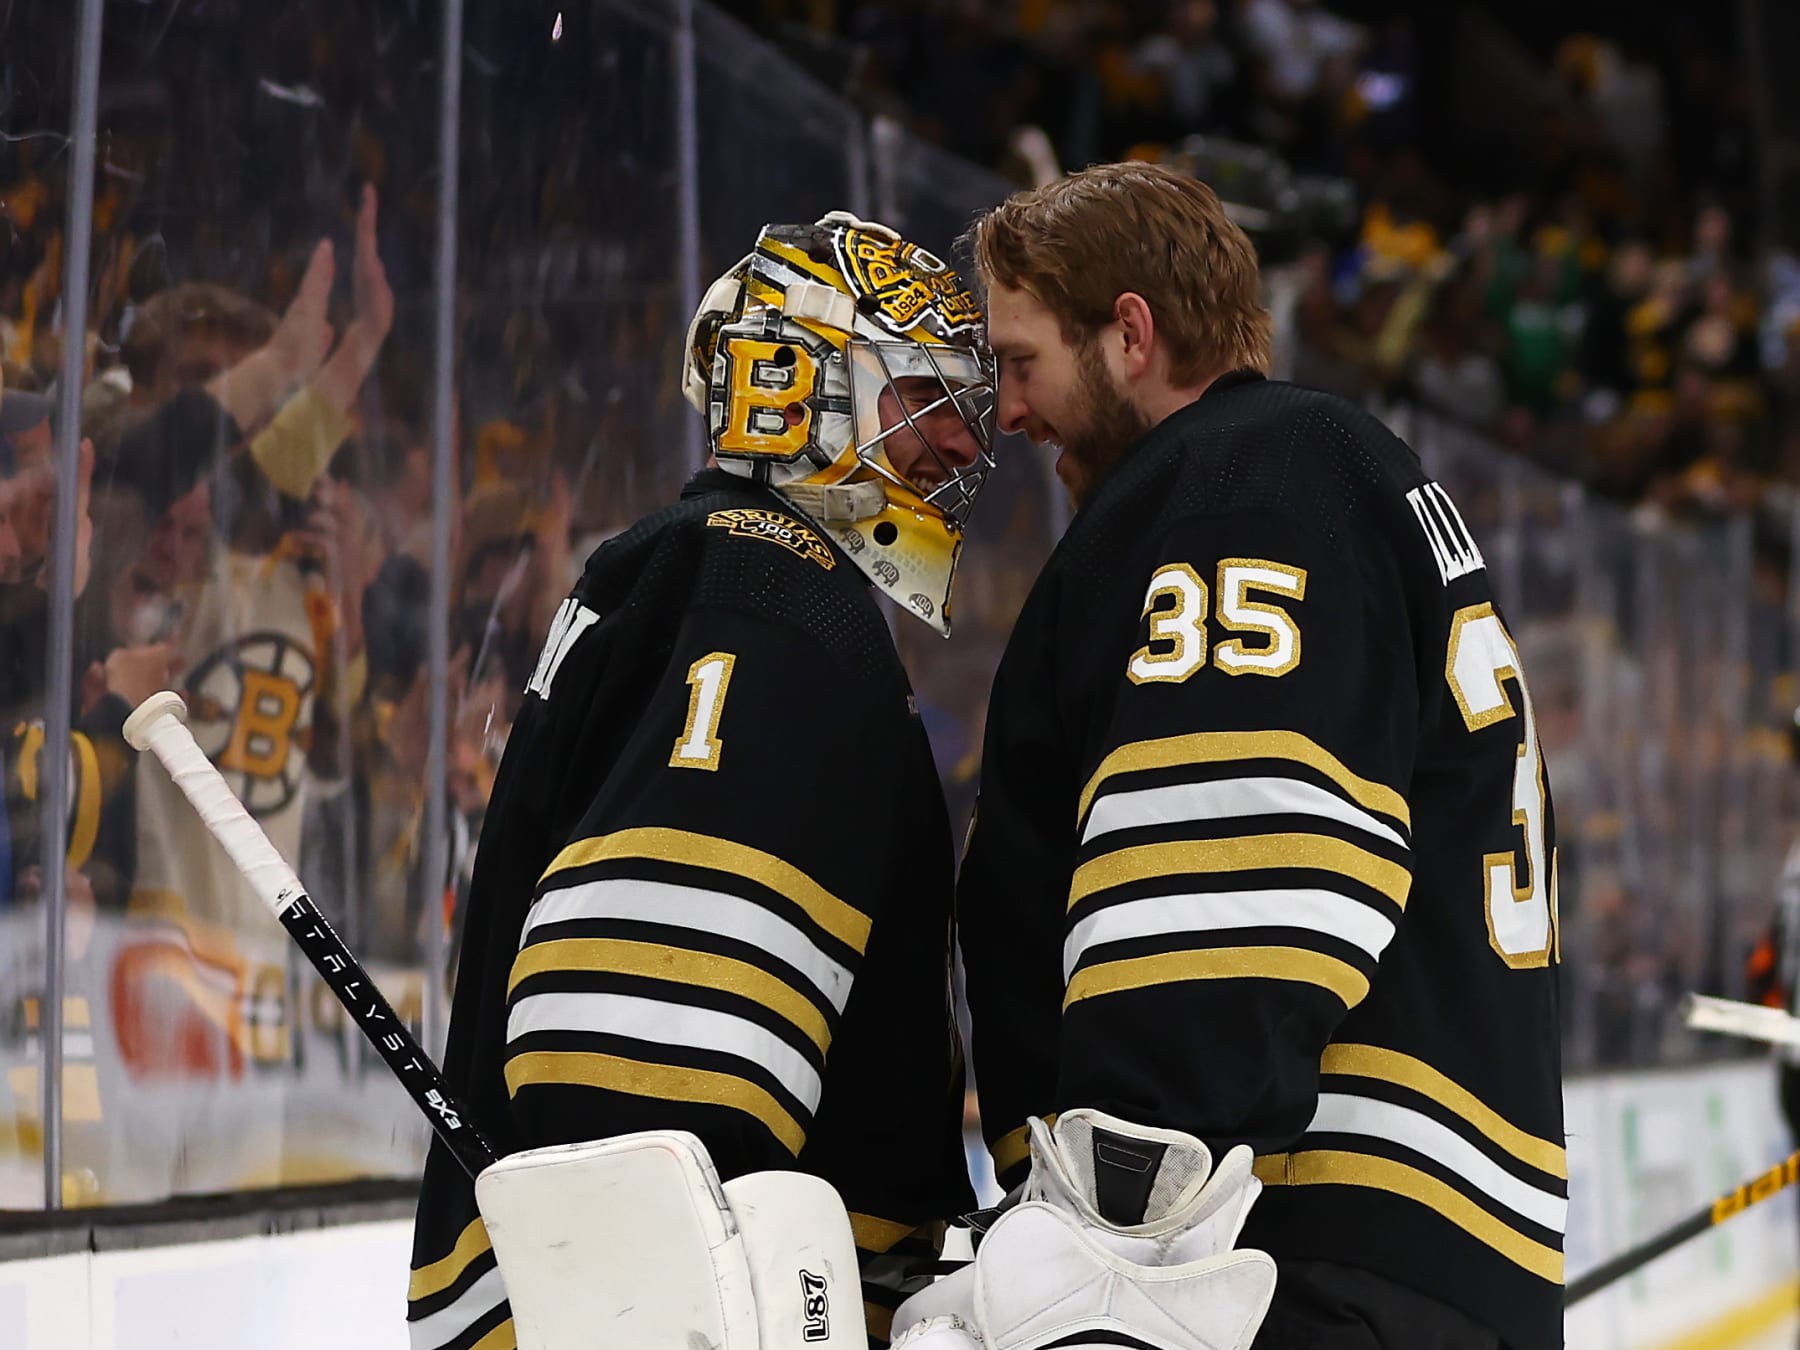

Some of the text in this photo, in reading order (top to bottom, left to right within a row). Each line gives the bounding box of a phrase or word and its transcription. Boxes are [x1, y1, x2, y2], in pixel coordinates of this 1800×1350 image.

[719, 337, 817, 457] B
[719, 508, 831, 558] BRUINS
[758, 521, 792, 540] 100
[1126, 556, 1308, 687] 35
[667, 651, 737, 772] 1
[1444, 600, 1561, 970] 3
[799, 1268, 830, 1343] L87
